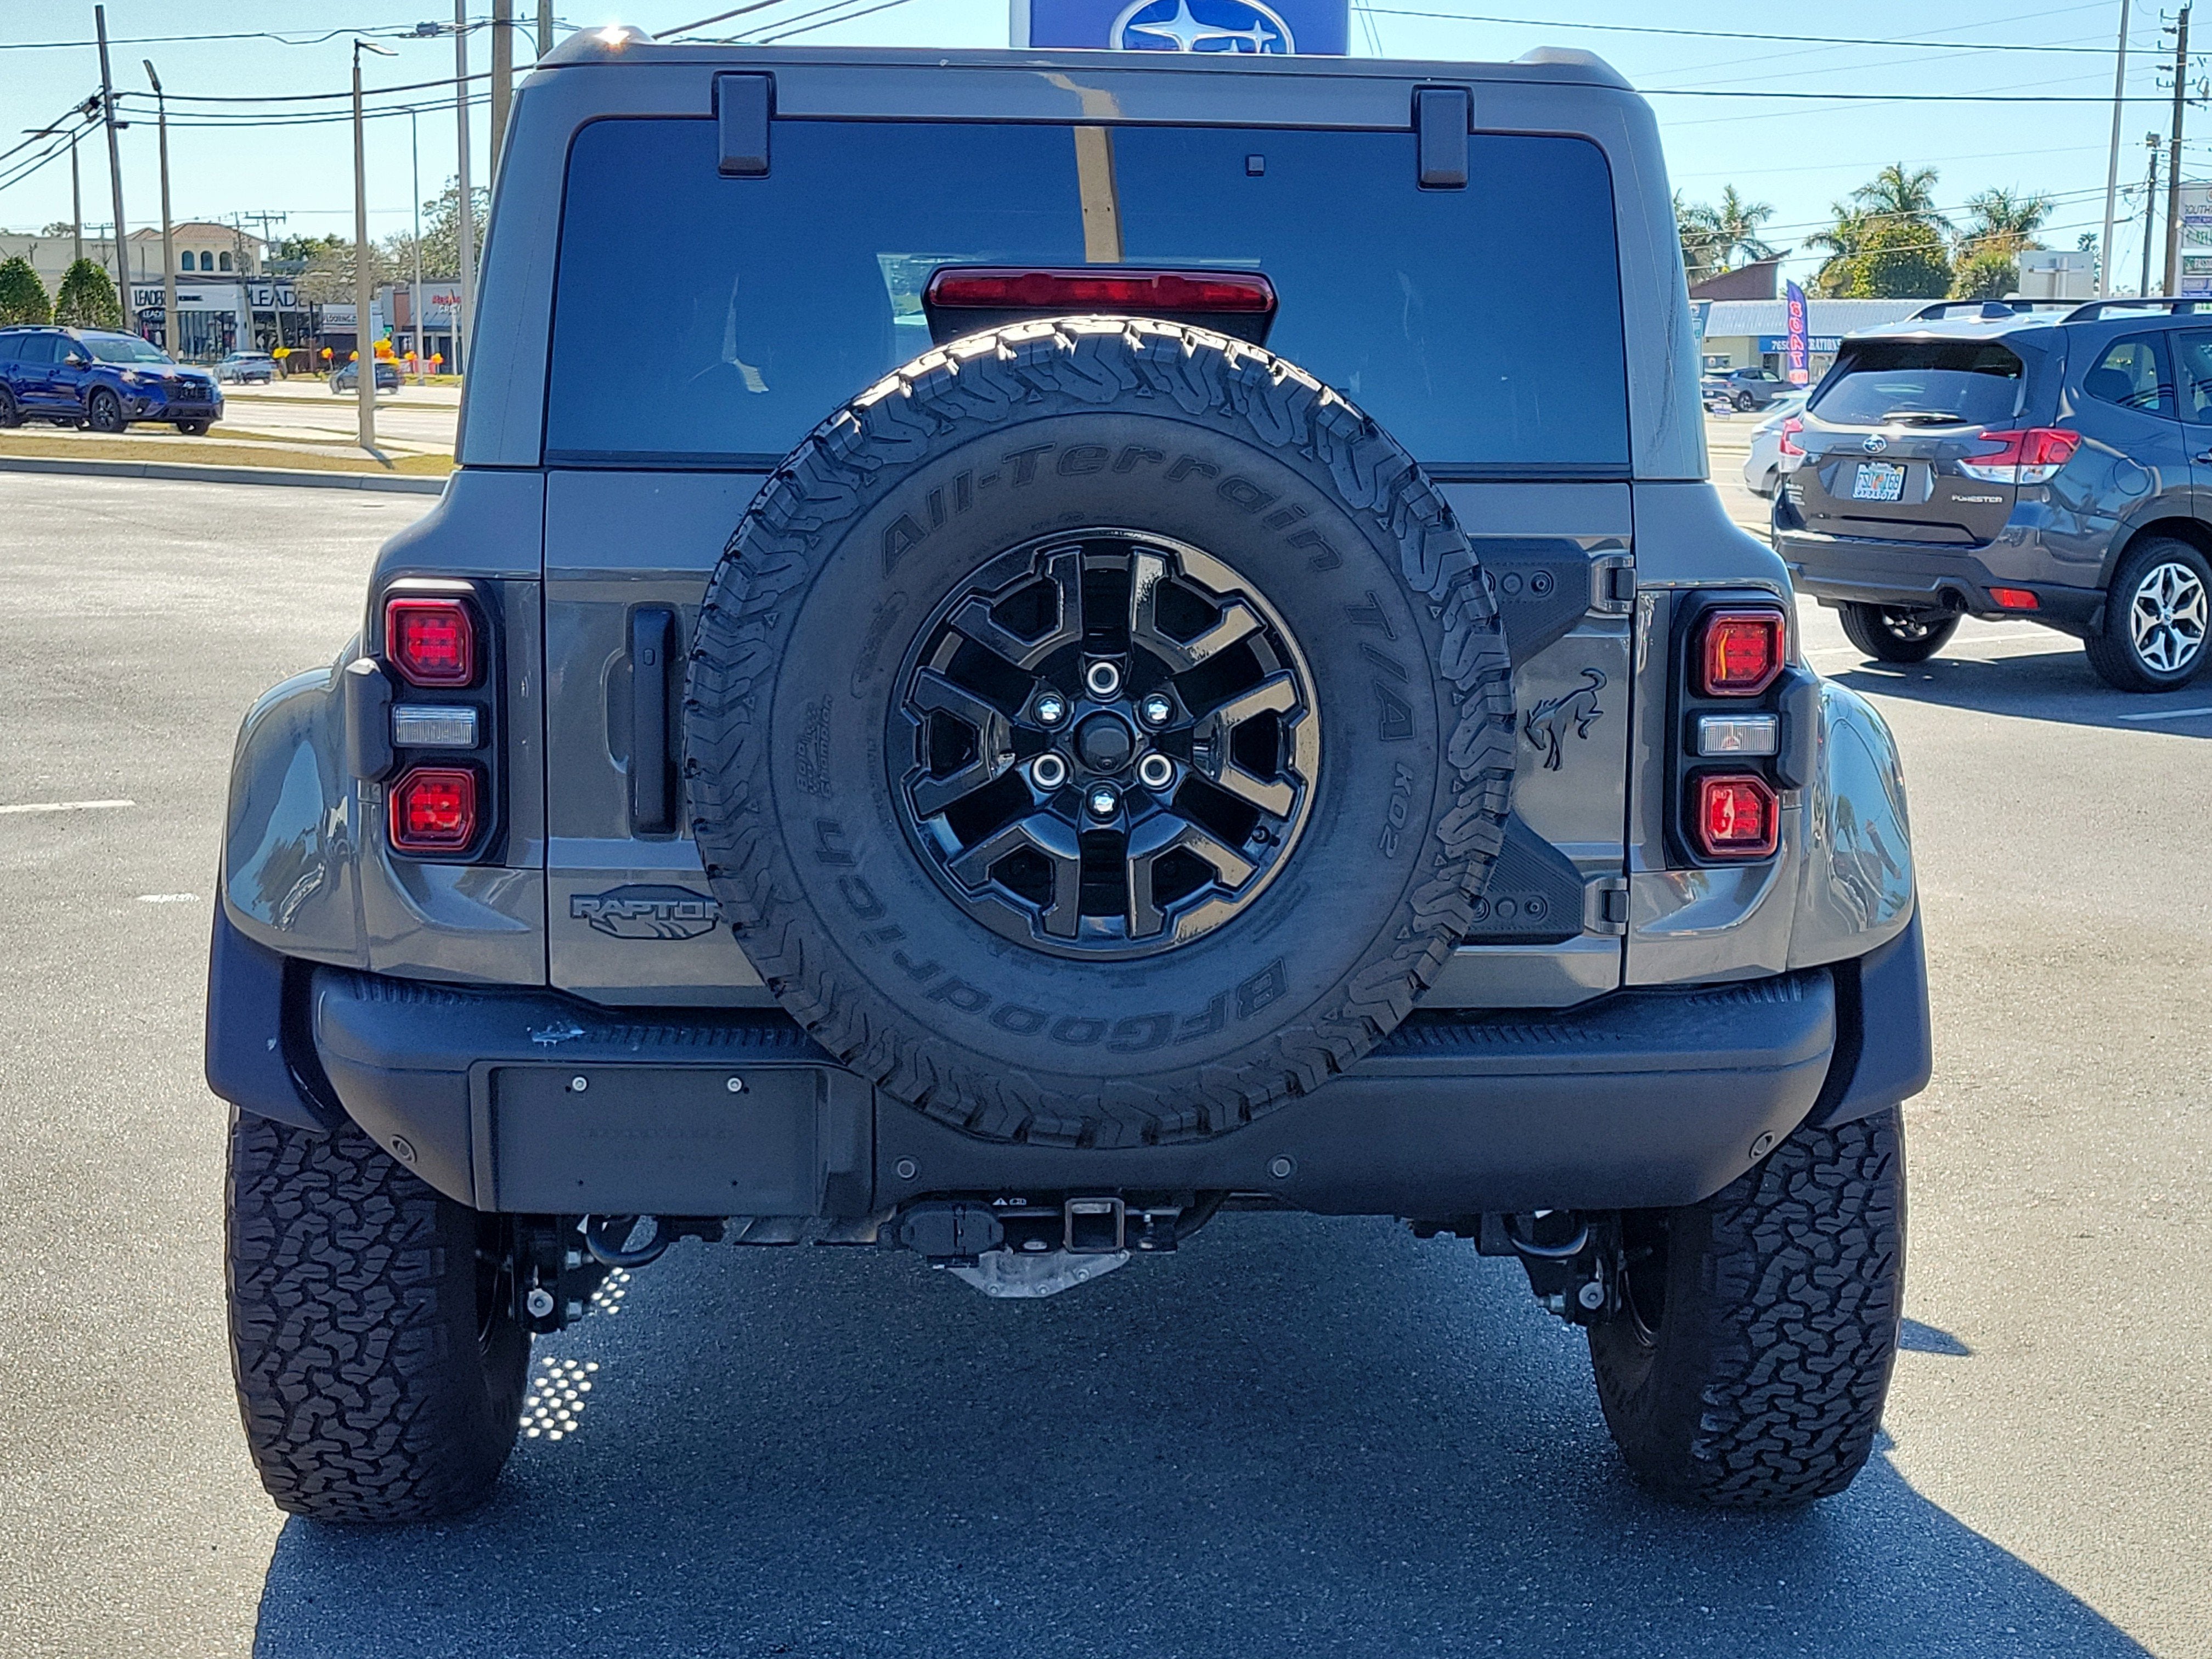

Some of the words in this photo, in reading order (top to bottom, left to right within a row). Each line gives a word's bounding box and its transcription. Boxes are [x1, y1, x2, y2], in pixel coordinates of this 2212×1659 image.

[1789, 301, 1804, 367] BOAT
[1951, 494, 2002, 503] FORESTER
[1344, 591, 1415, 740] T/A
[814, 817, 1289, 1054] BFGoodrich
